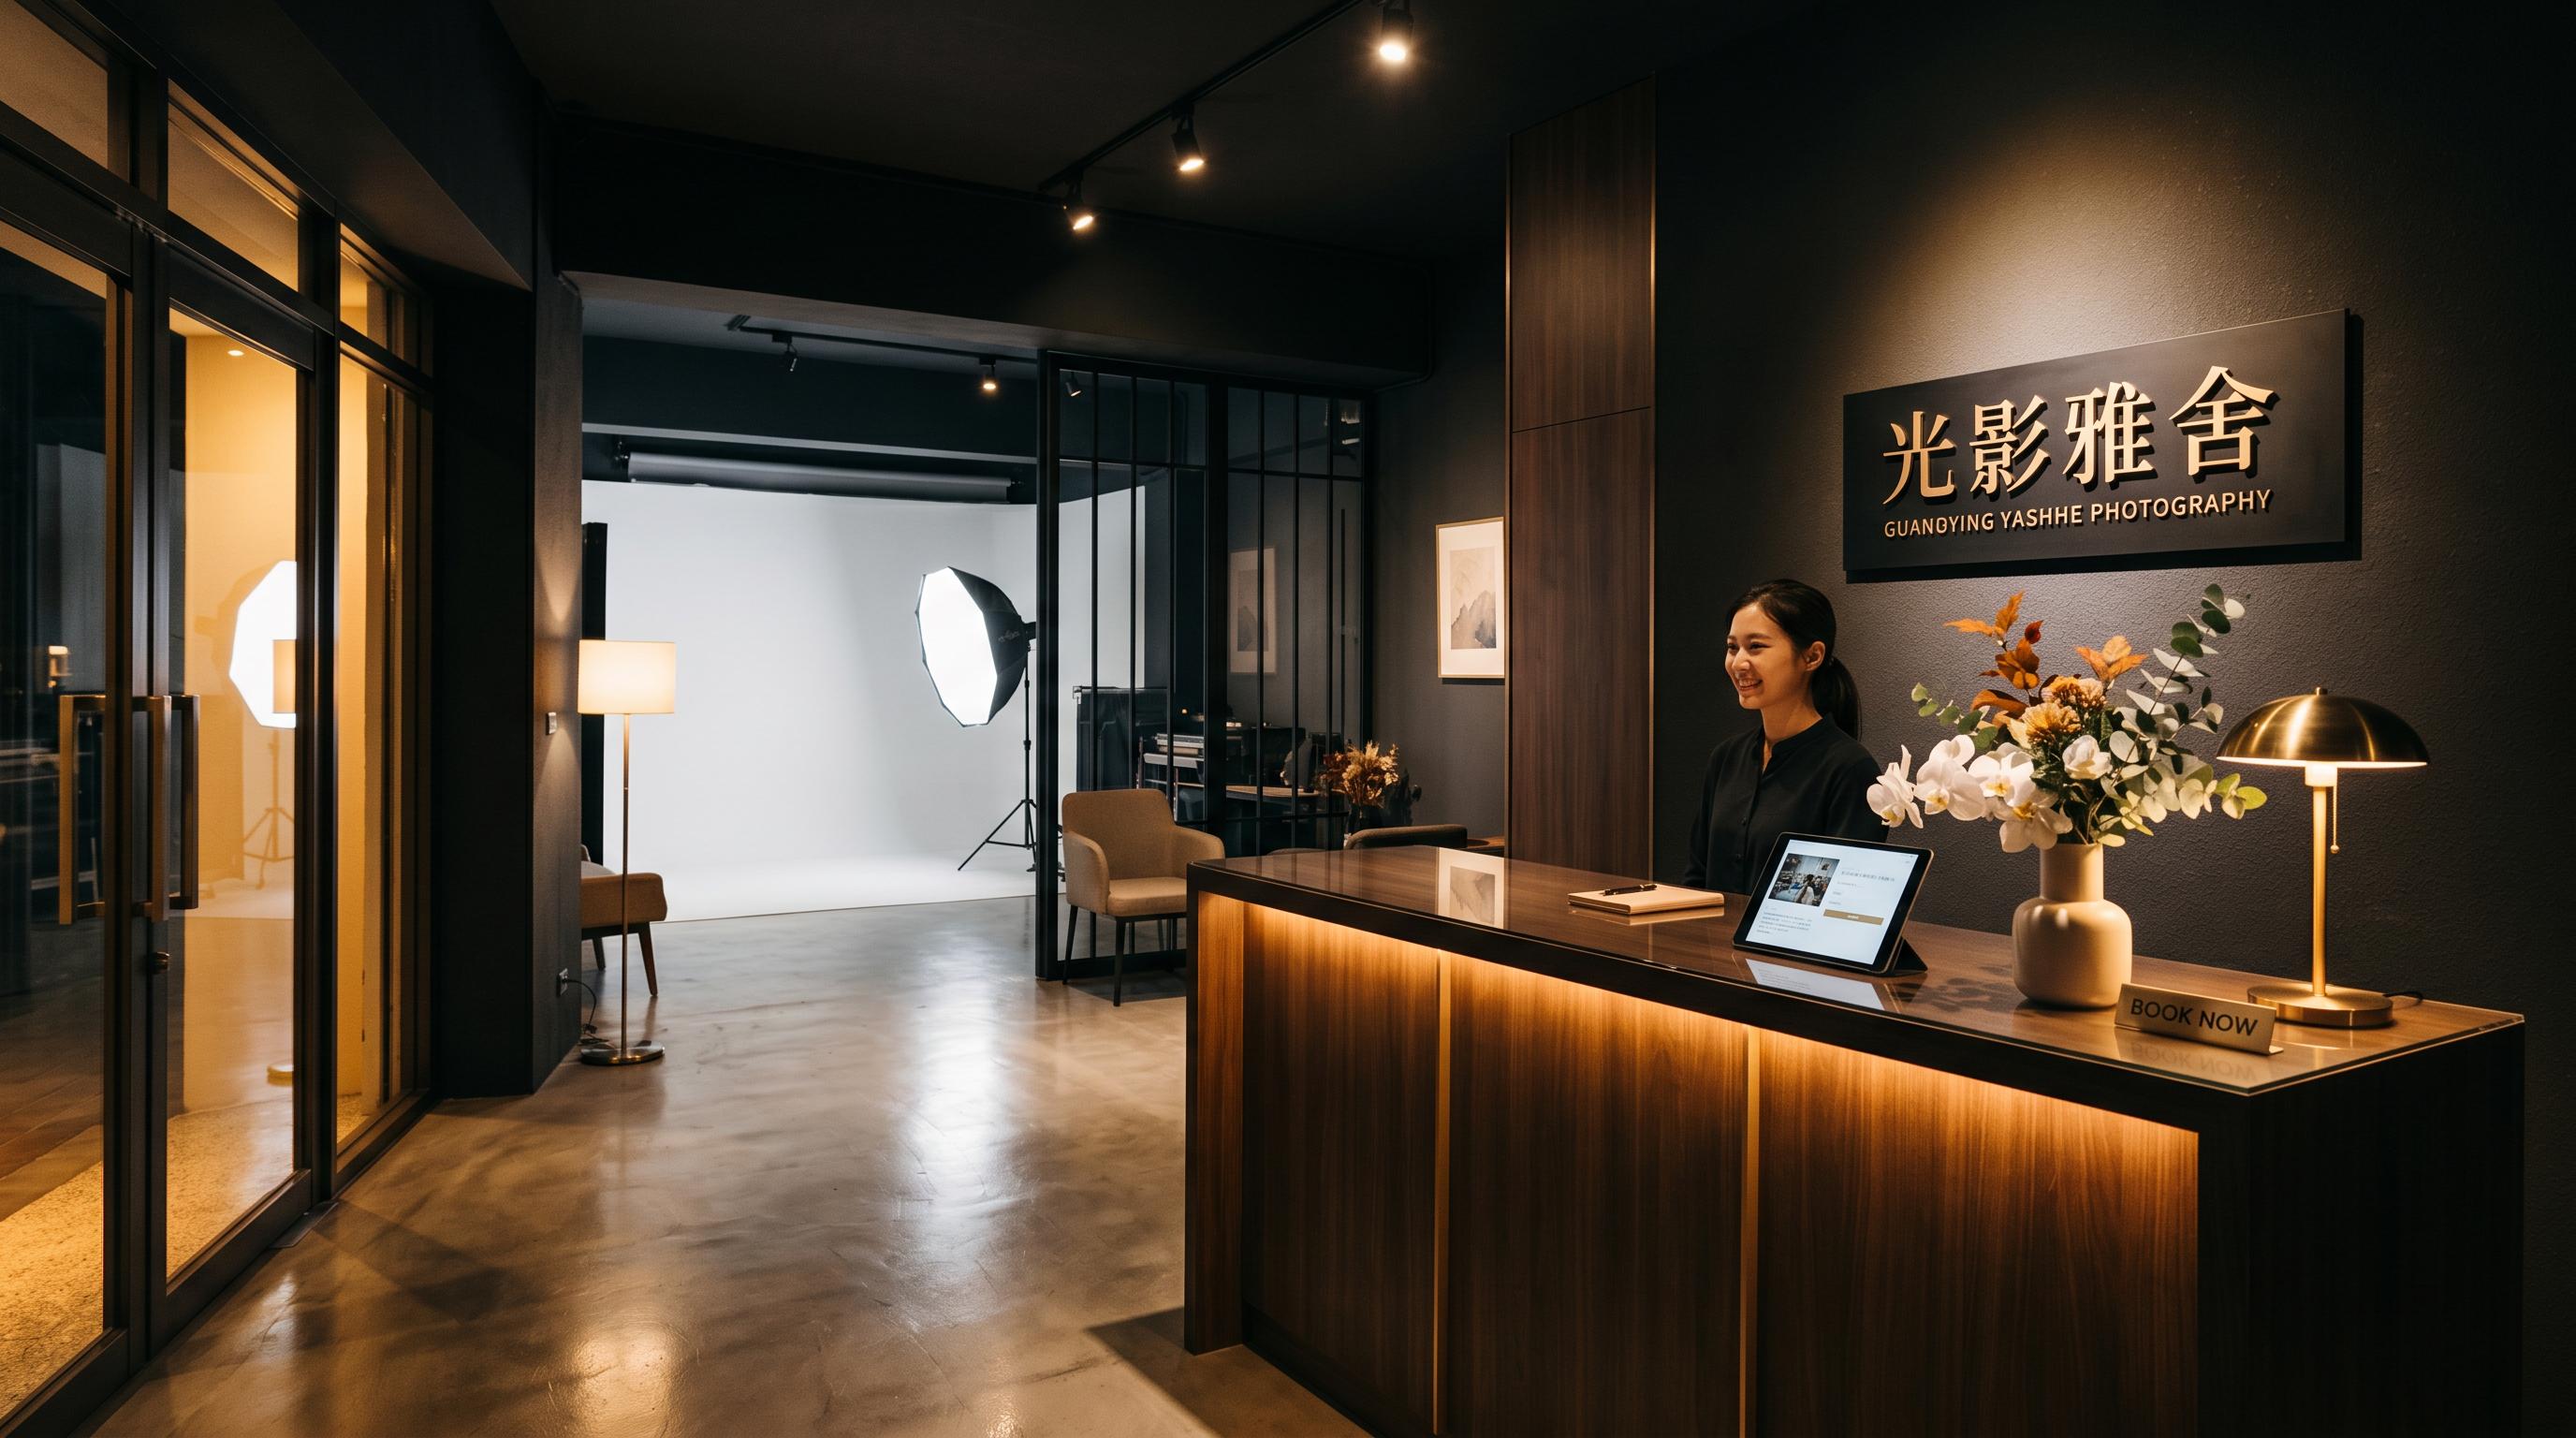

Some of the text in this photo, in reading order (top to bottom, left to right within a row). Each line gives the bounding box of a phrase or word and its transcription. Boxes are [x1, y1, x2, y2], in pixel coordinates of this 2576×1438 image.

[1881, 365, 2277, 506] 光影雅舍
[2000, 504, 2083, 530] YASHHE
[2090, 489, 2272, 522] PHOTOGRAPHY
[2130, 998, 2259, 1036] BOOK NOW
